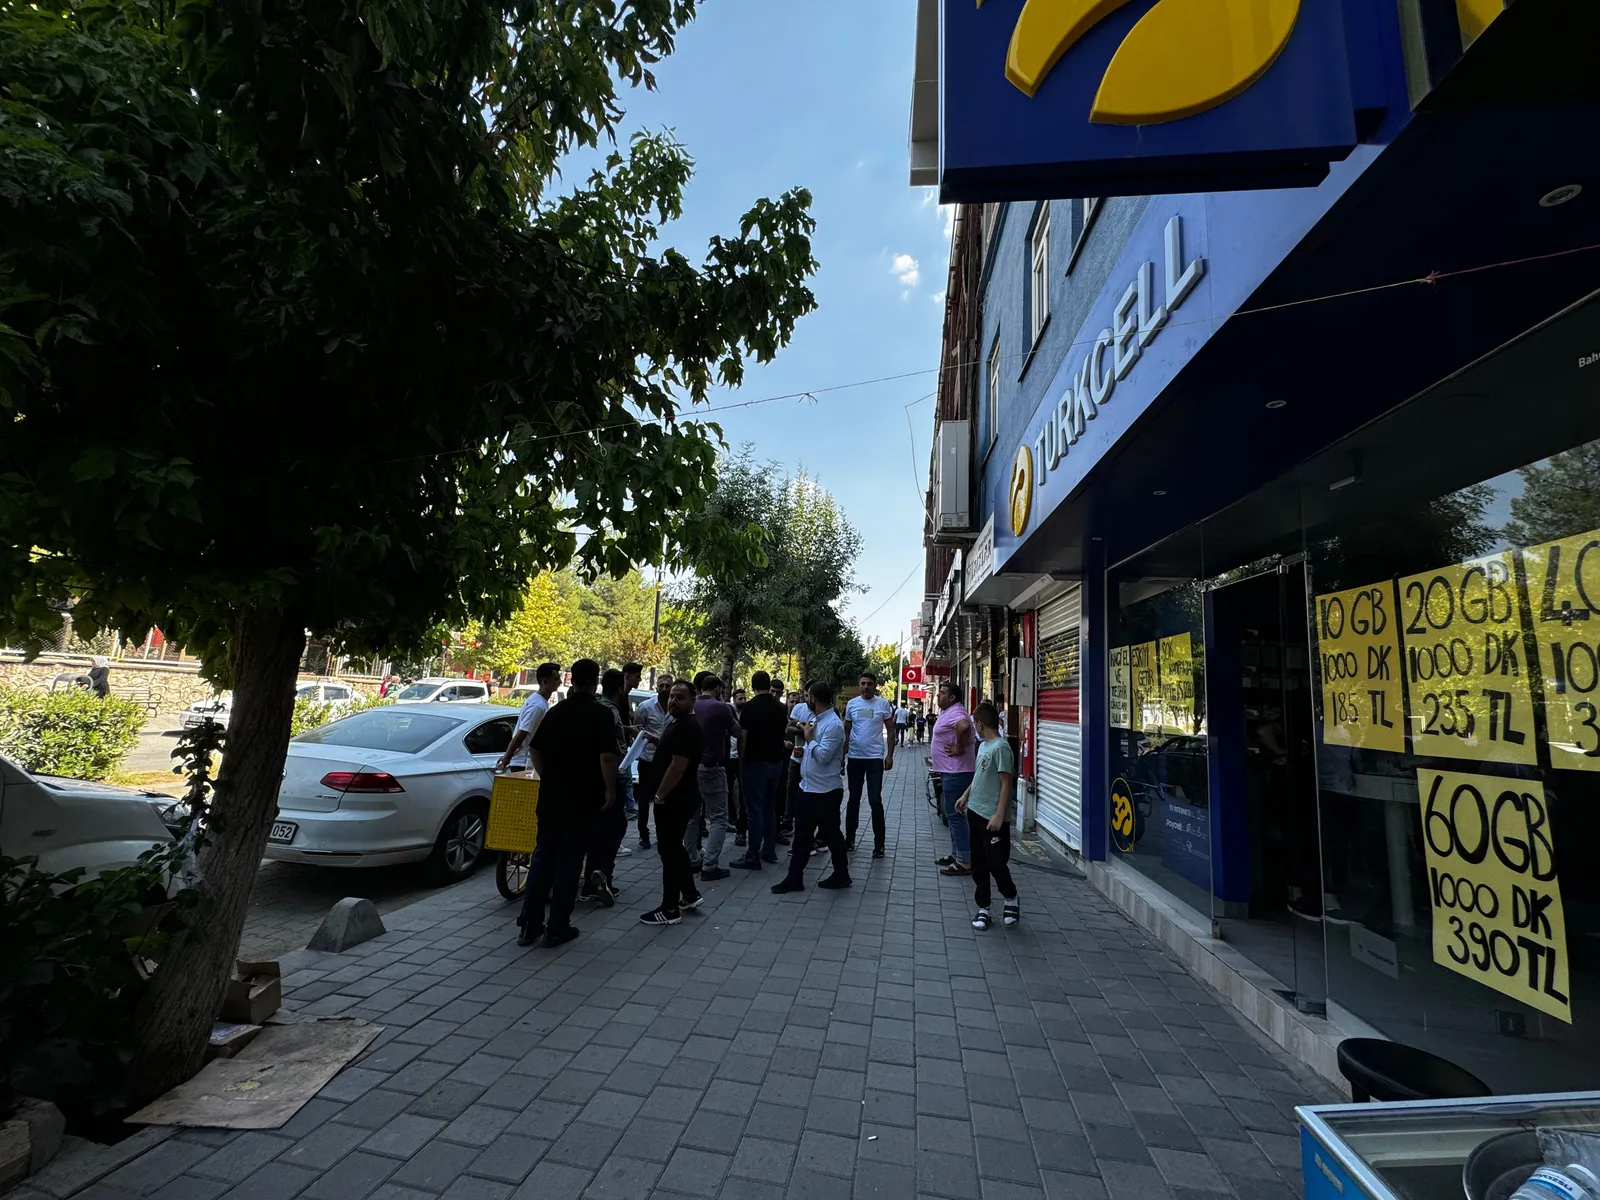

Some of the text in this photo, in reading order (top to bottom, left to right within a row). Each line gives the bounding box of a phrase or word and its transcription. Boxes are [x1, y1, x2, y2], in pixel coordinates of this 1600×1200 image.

[1035, 213, 1203, 486] TURKCELL
[1578, 352, 1600, 369] Bah
[1323, 645, 1392, 684] 1000 DK
[1409, 630, 1520, 683] 1000 DK
[1551, 642, 1600, 695] 10
[1332, 690, 1394, 729] 185 TL
[1421, 689, 1525, 745] 235 TL
[272, 825, 293, 838] 052
[1430, 867, 1553, 940] 1000 DK
